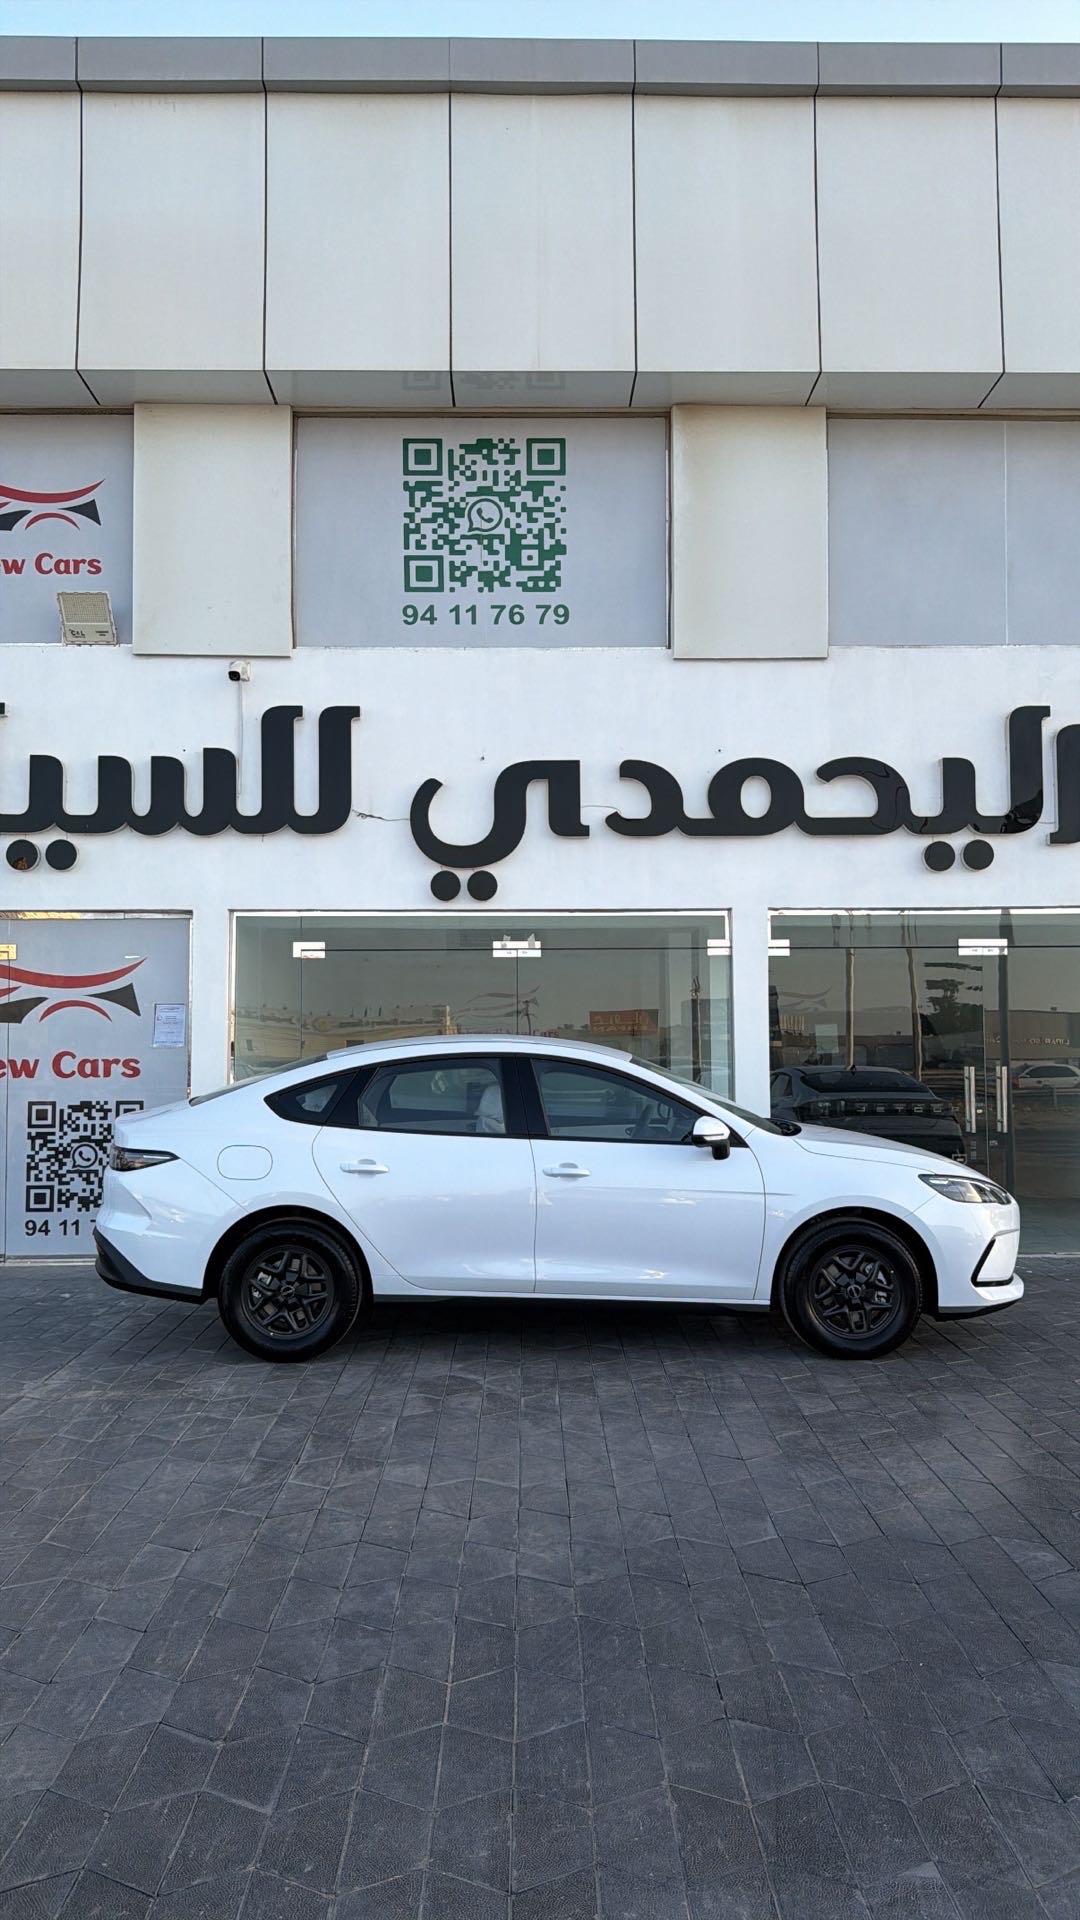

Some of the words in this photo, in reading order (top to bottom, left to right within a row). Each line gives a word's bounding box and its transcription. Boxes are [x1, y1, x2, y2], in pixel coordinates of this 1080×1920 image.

[0, 559, 26, 575] w
[34, 552, 102, 575] Cars
[402, 604, 438, 625] 94
[449, 604, 477, 625] 11
[490, 604, 525, 625] 76
[535, 604, 570, 625] 79
[0, 703, 361, 871] للسي
[51, 1050, 142, 1079] Cars
[24, 1219, 51, 1237] 94
[58, 1219, 80, 1237] 11
